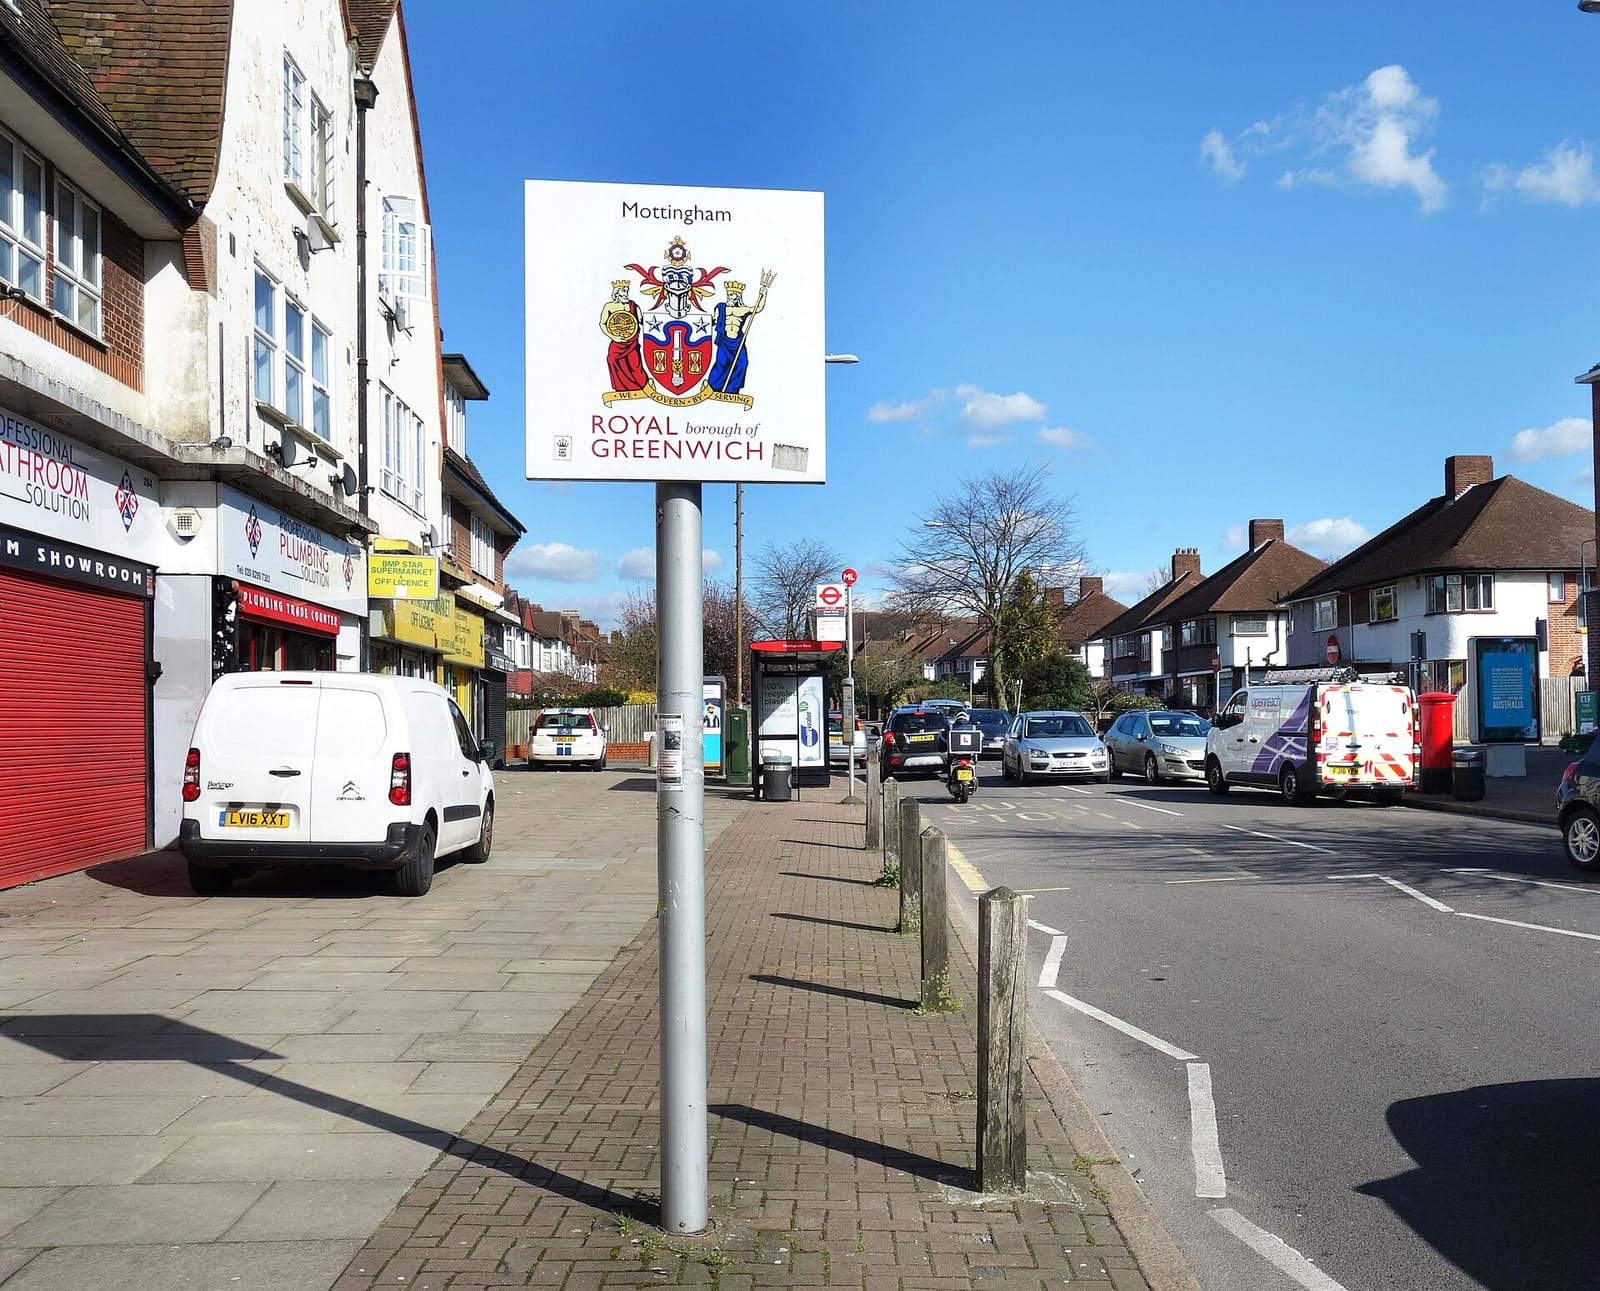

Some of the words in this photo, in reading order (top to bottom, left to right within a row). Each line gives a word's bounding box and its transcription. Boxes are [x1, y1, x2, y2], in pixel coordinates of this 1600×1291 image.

[622, 202, 732, 225] Mottingham
[650, 392, 686, 405] GOVERN
[693, 394, 703, 404] BY
[714, 393, 750, 404] SERVING
[591, 415, 678, 435] ROYAL
[685, 422, 742, 438] borough
[745, 423, 761, 438] of
[591, 439, 763, 461] GREENWICH
[0, 440, 89, 502] THROOM
[25, 482, 90, 522] SOLUTION
[280, 516, 322, 546] PROFESSIONAL
[0, 539, 20, 556] M
[37, 547, 142, 585] SHOWROOM
[280, 533, 330, 573] PLUMBING
[371, 566, 434, 576] SUPERMARKET
[382, 560, 400, 568] BMP
[402, 560, 423, 569] STAR
[301, 565, 330, 588] SOLUTION
[393, 579, 429, 587] LICENCE
[843, 573, 856, 581] ML
[243, 591, 283, 612] PLUMBING
[286, 603, 308, 619] TRADE
[311, 609, 338, 627] COUNTER
[1251, 696, 1281, 709] openreach
[1492, 700, 1524, 710] AUSTRALIA
[230, 812, 258, 825] LV16
[261, 813, 286, 826] XXT
